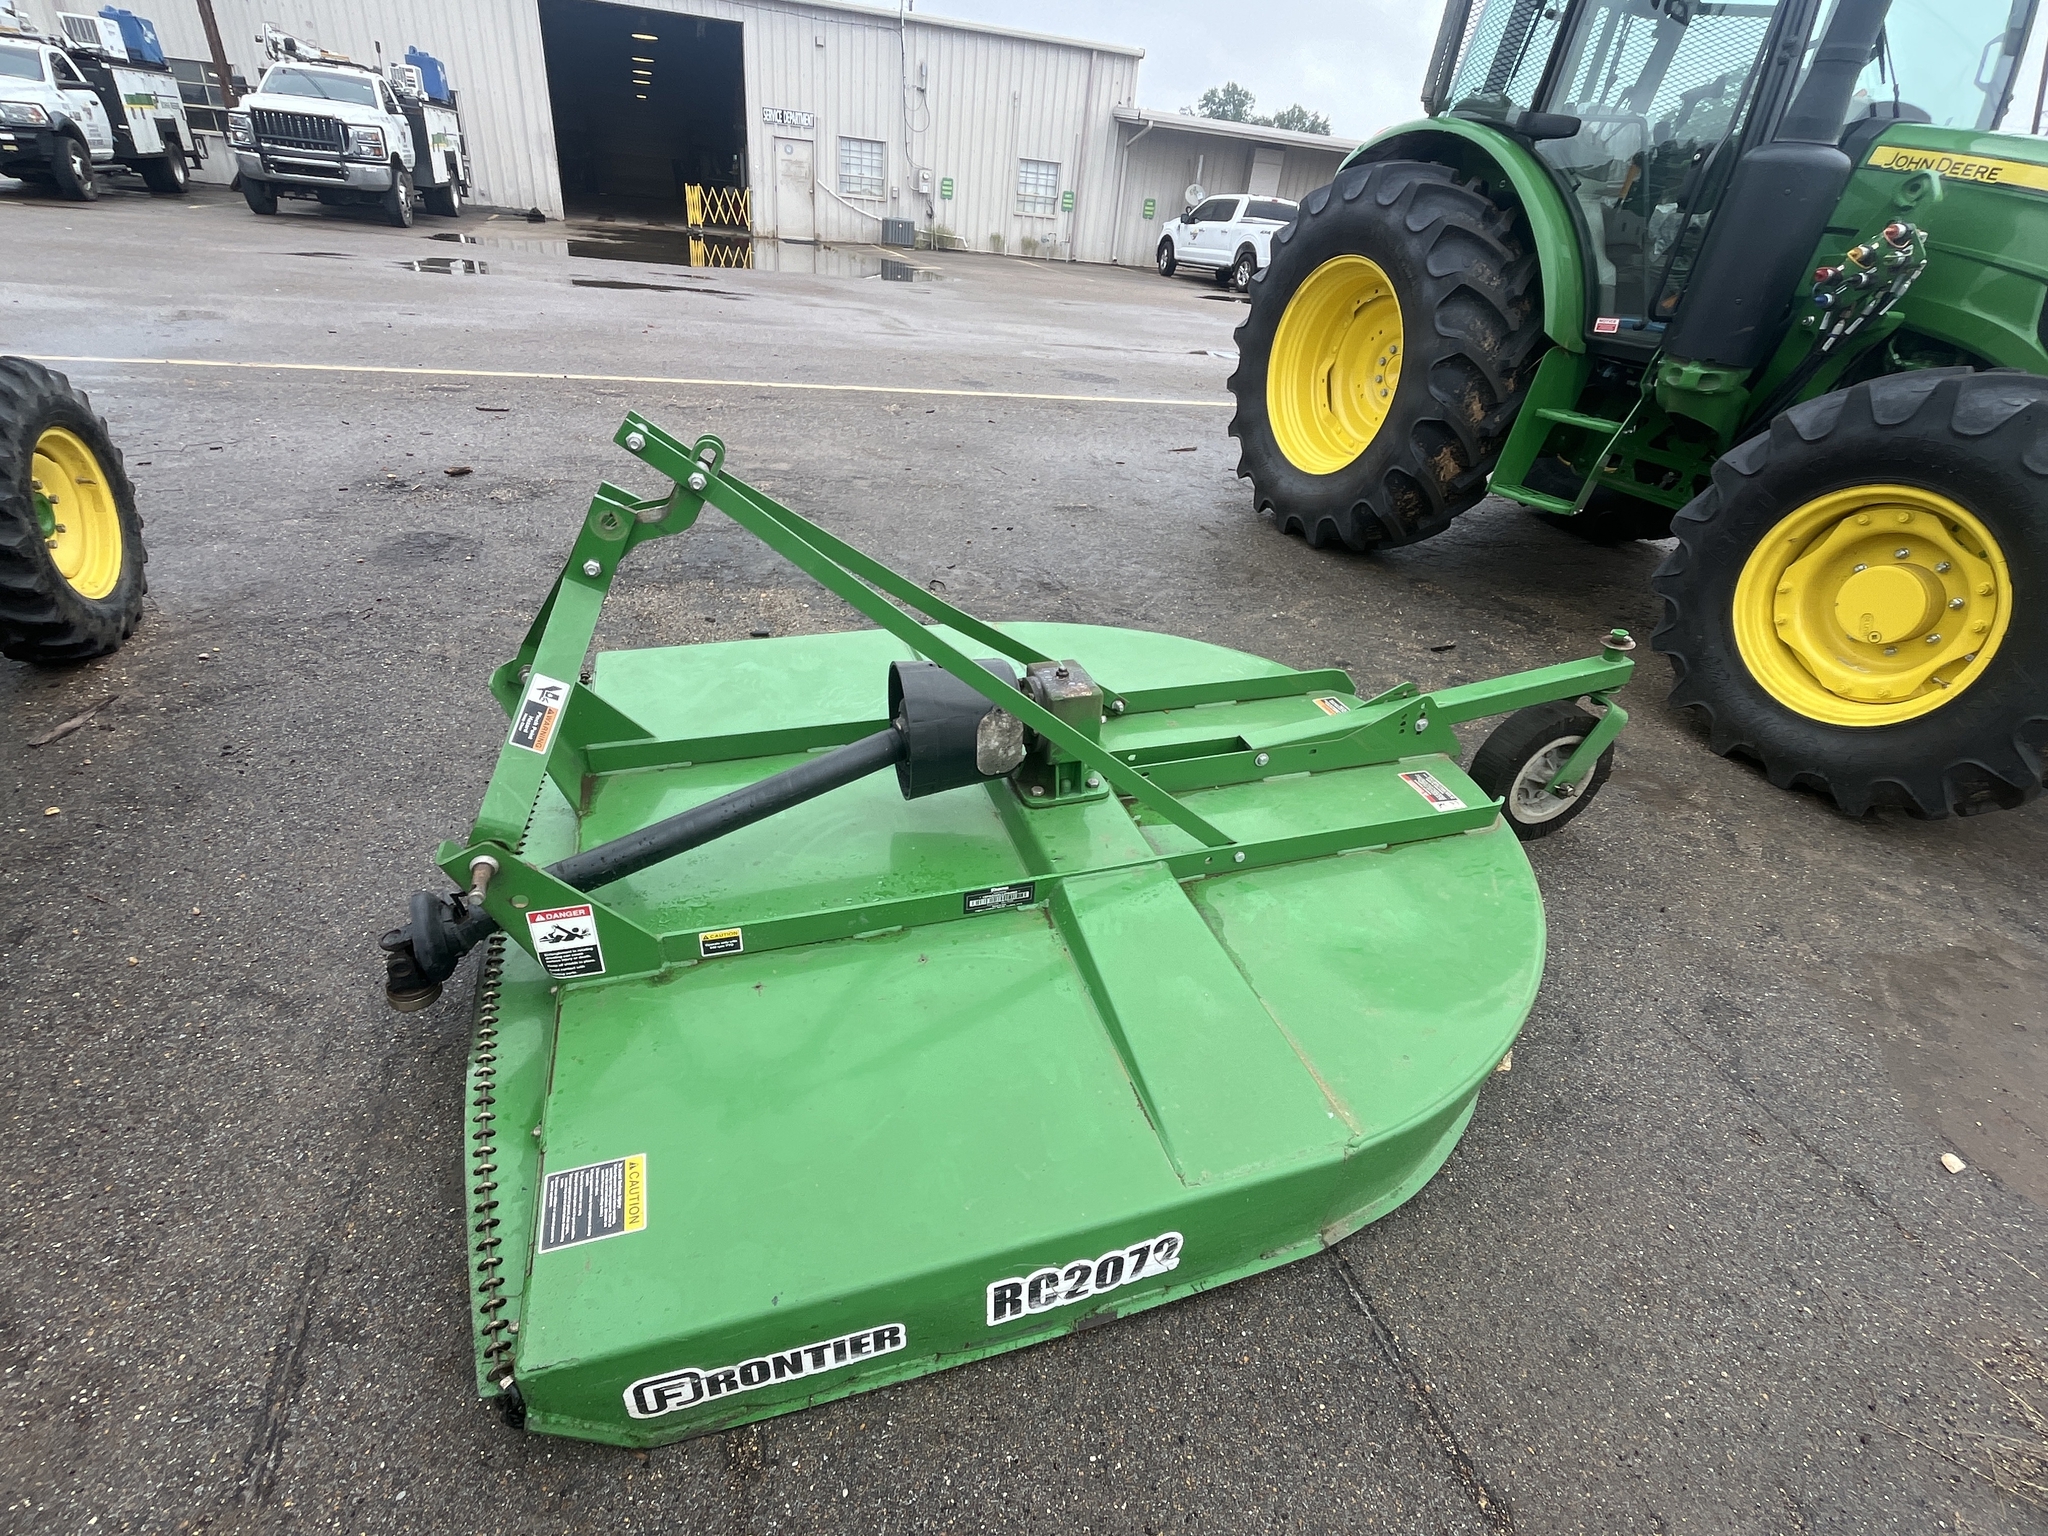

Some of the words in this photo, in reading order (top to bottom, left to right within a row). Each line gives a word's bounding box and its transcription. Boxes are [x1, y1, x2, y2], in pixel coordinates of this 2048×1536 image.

[1884, 152, 1936, 170] JOHN
[1936, 157, 2003, 181] DEERE
[535, 713, 553, 749] WARNING
[545, 908, 586, 921] DANGER
[709, 931, 738, 939] CAUTION
[629, 1171, 640, 1225] CAUTION
[633, 1325, 901, 1415] FRONTIER
